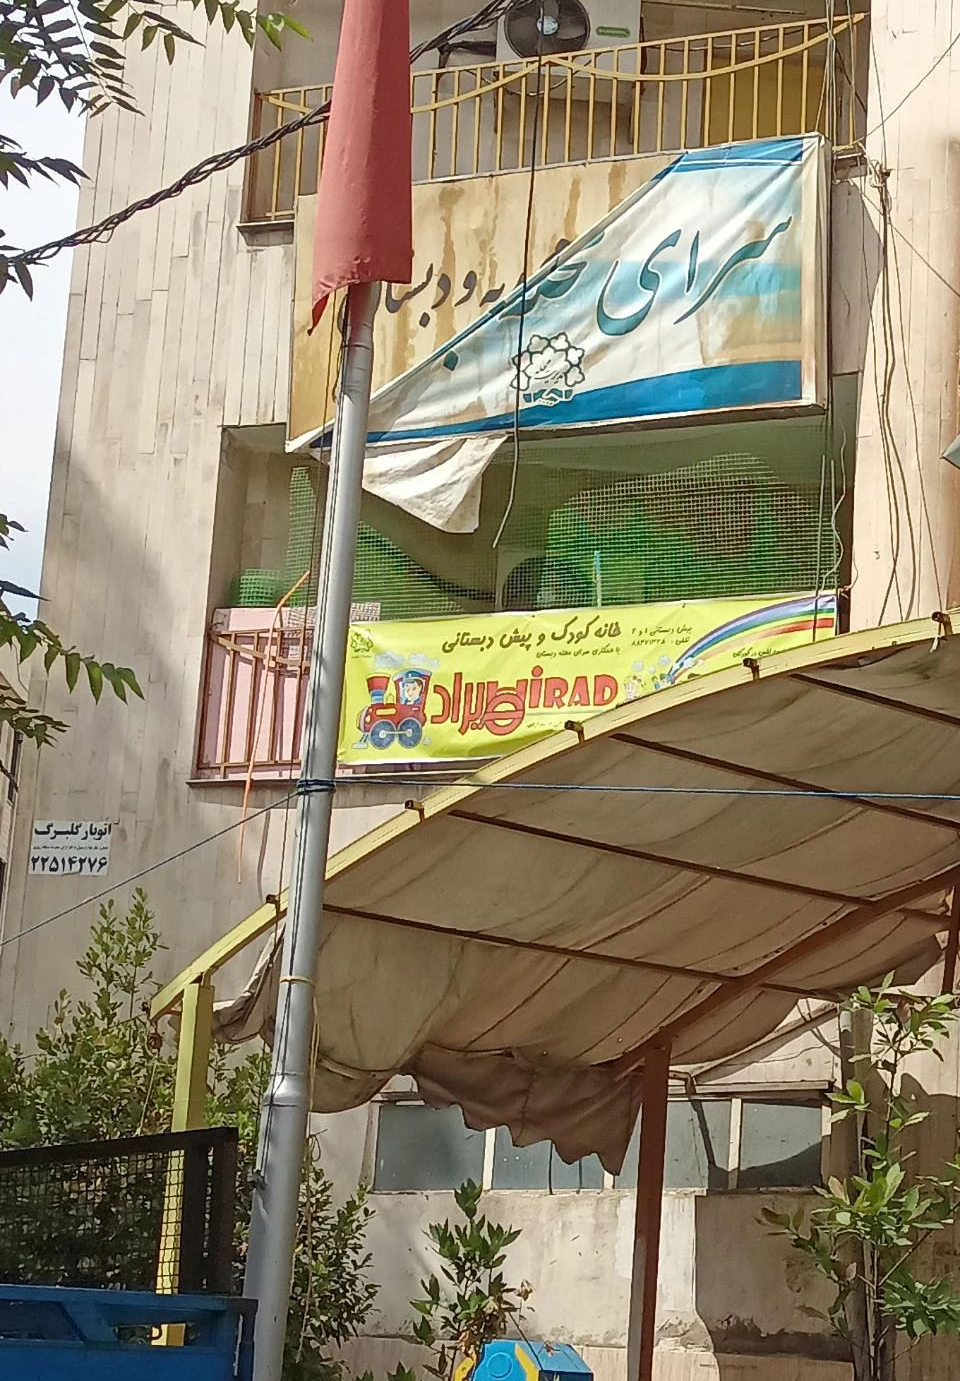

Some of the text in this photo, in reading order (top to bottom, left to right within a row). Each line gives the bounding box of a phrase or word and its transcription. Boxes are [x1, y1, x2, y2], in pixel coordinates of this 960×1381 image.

[596, 216, 792, 336] سرای
[441, 615, 622, 654] خانه کودک و پیش دبستانی
[591, 643, 615, 656] همکاری
[34, 822, 112, 841] اتوبار گلبرگ
